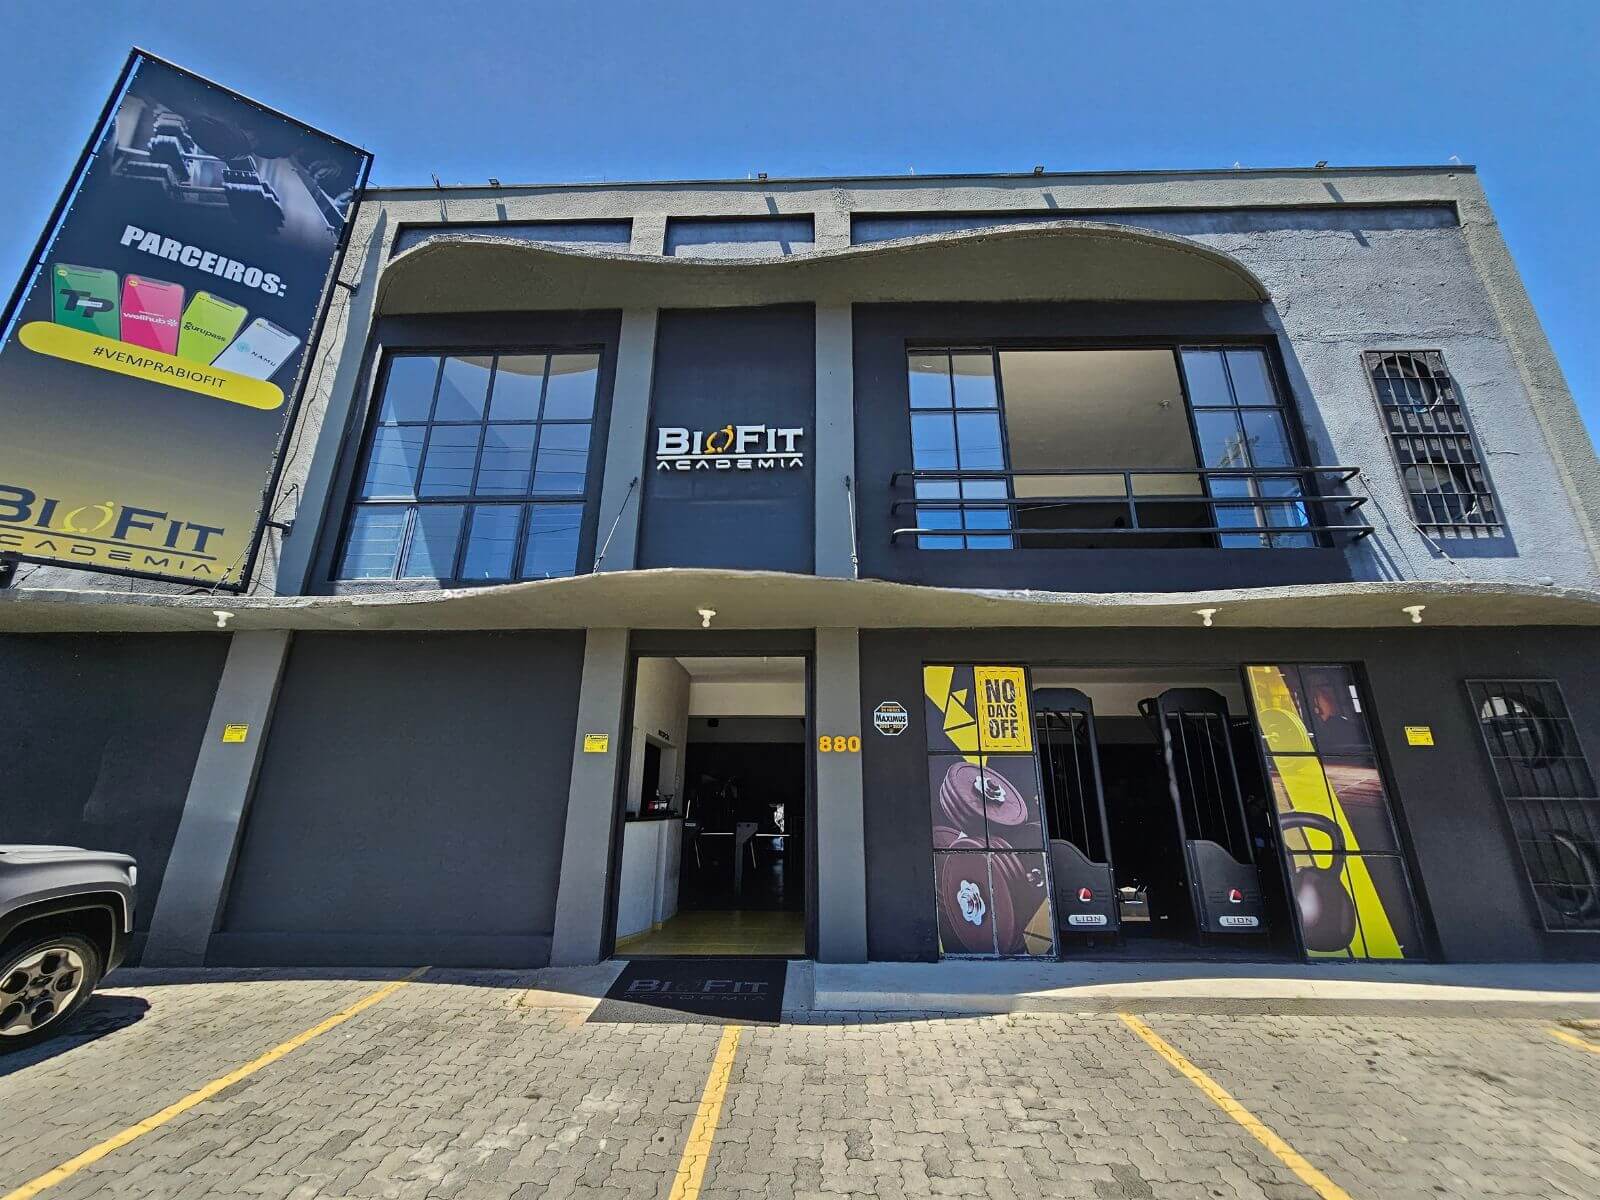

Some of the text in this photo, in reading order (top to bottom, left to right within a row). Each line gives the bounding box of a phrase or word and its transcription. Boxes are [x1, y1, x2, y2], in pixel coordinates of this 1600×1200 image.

[120, 225, 287, 297] PARCEIROS:
[123, 312, 167, 325] wellhub
[183, 321, 226, 342] gurupass
[93, 346, 226, 388] #VEMPRABIOFIT
[251, 351, 277, 367] NAMU
[656, 457, 804, 470] ACADEMIA
[0, 533, 212, 574] CADEMIA
[985, 678, 1017, 704] NO
[875, 713, 907, 723] MAXIMUS
[987, 704, 1018, 718] DAYS
[989, 719, 1019, 739] OFF
[819, 735, 861, 752] 880
[1225, 916, 1253, 924] LION
